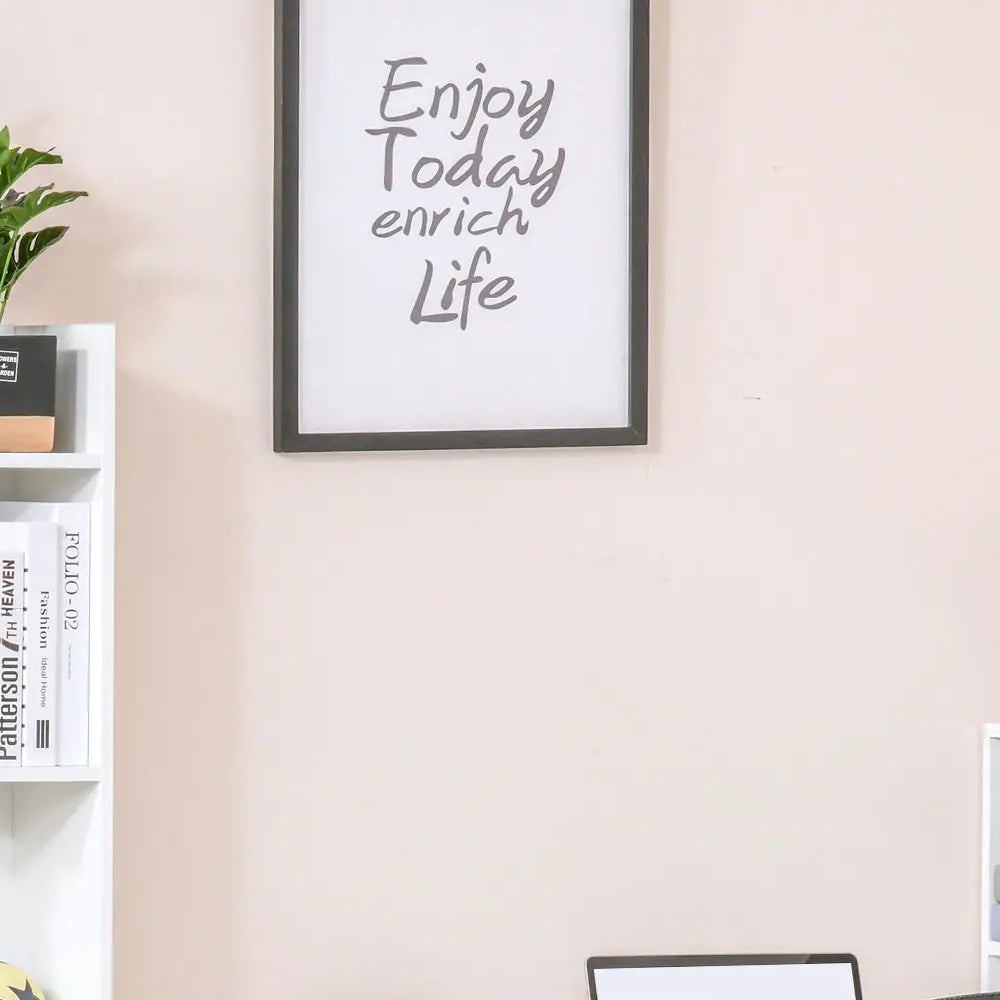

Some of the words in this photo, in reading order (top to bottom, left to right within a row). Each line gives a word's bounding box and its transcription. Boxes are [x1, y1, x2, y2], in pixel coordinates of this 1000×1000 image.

[379, 57, 555, 141] Enjoy
[364, 124, 566, 208] Today
[371, 186, 529, 239] enrich
[409, 246, 518, 331] Life
[1, 559, 16, 617] HEAVEN
[64, 531, 80, 595] FOLIO
[40, 590, 50, 649] Fashion
[64, 609, 79, 631] 02
